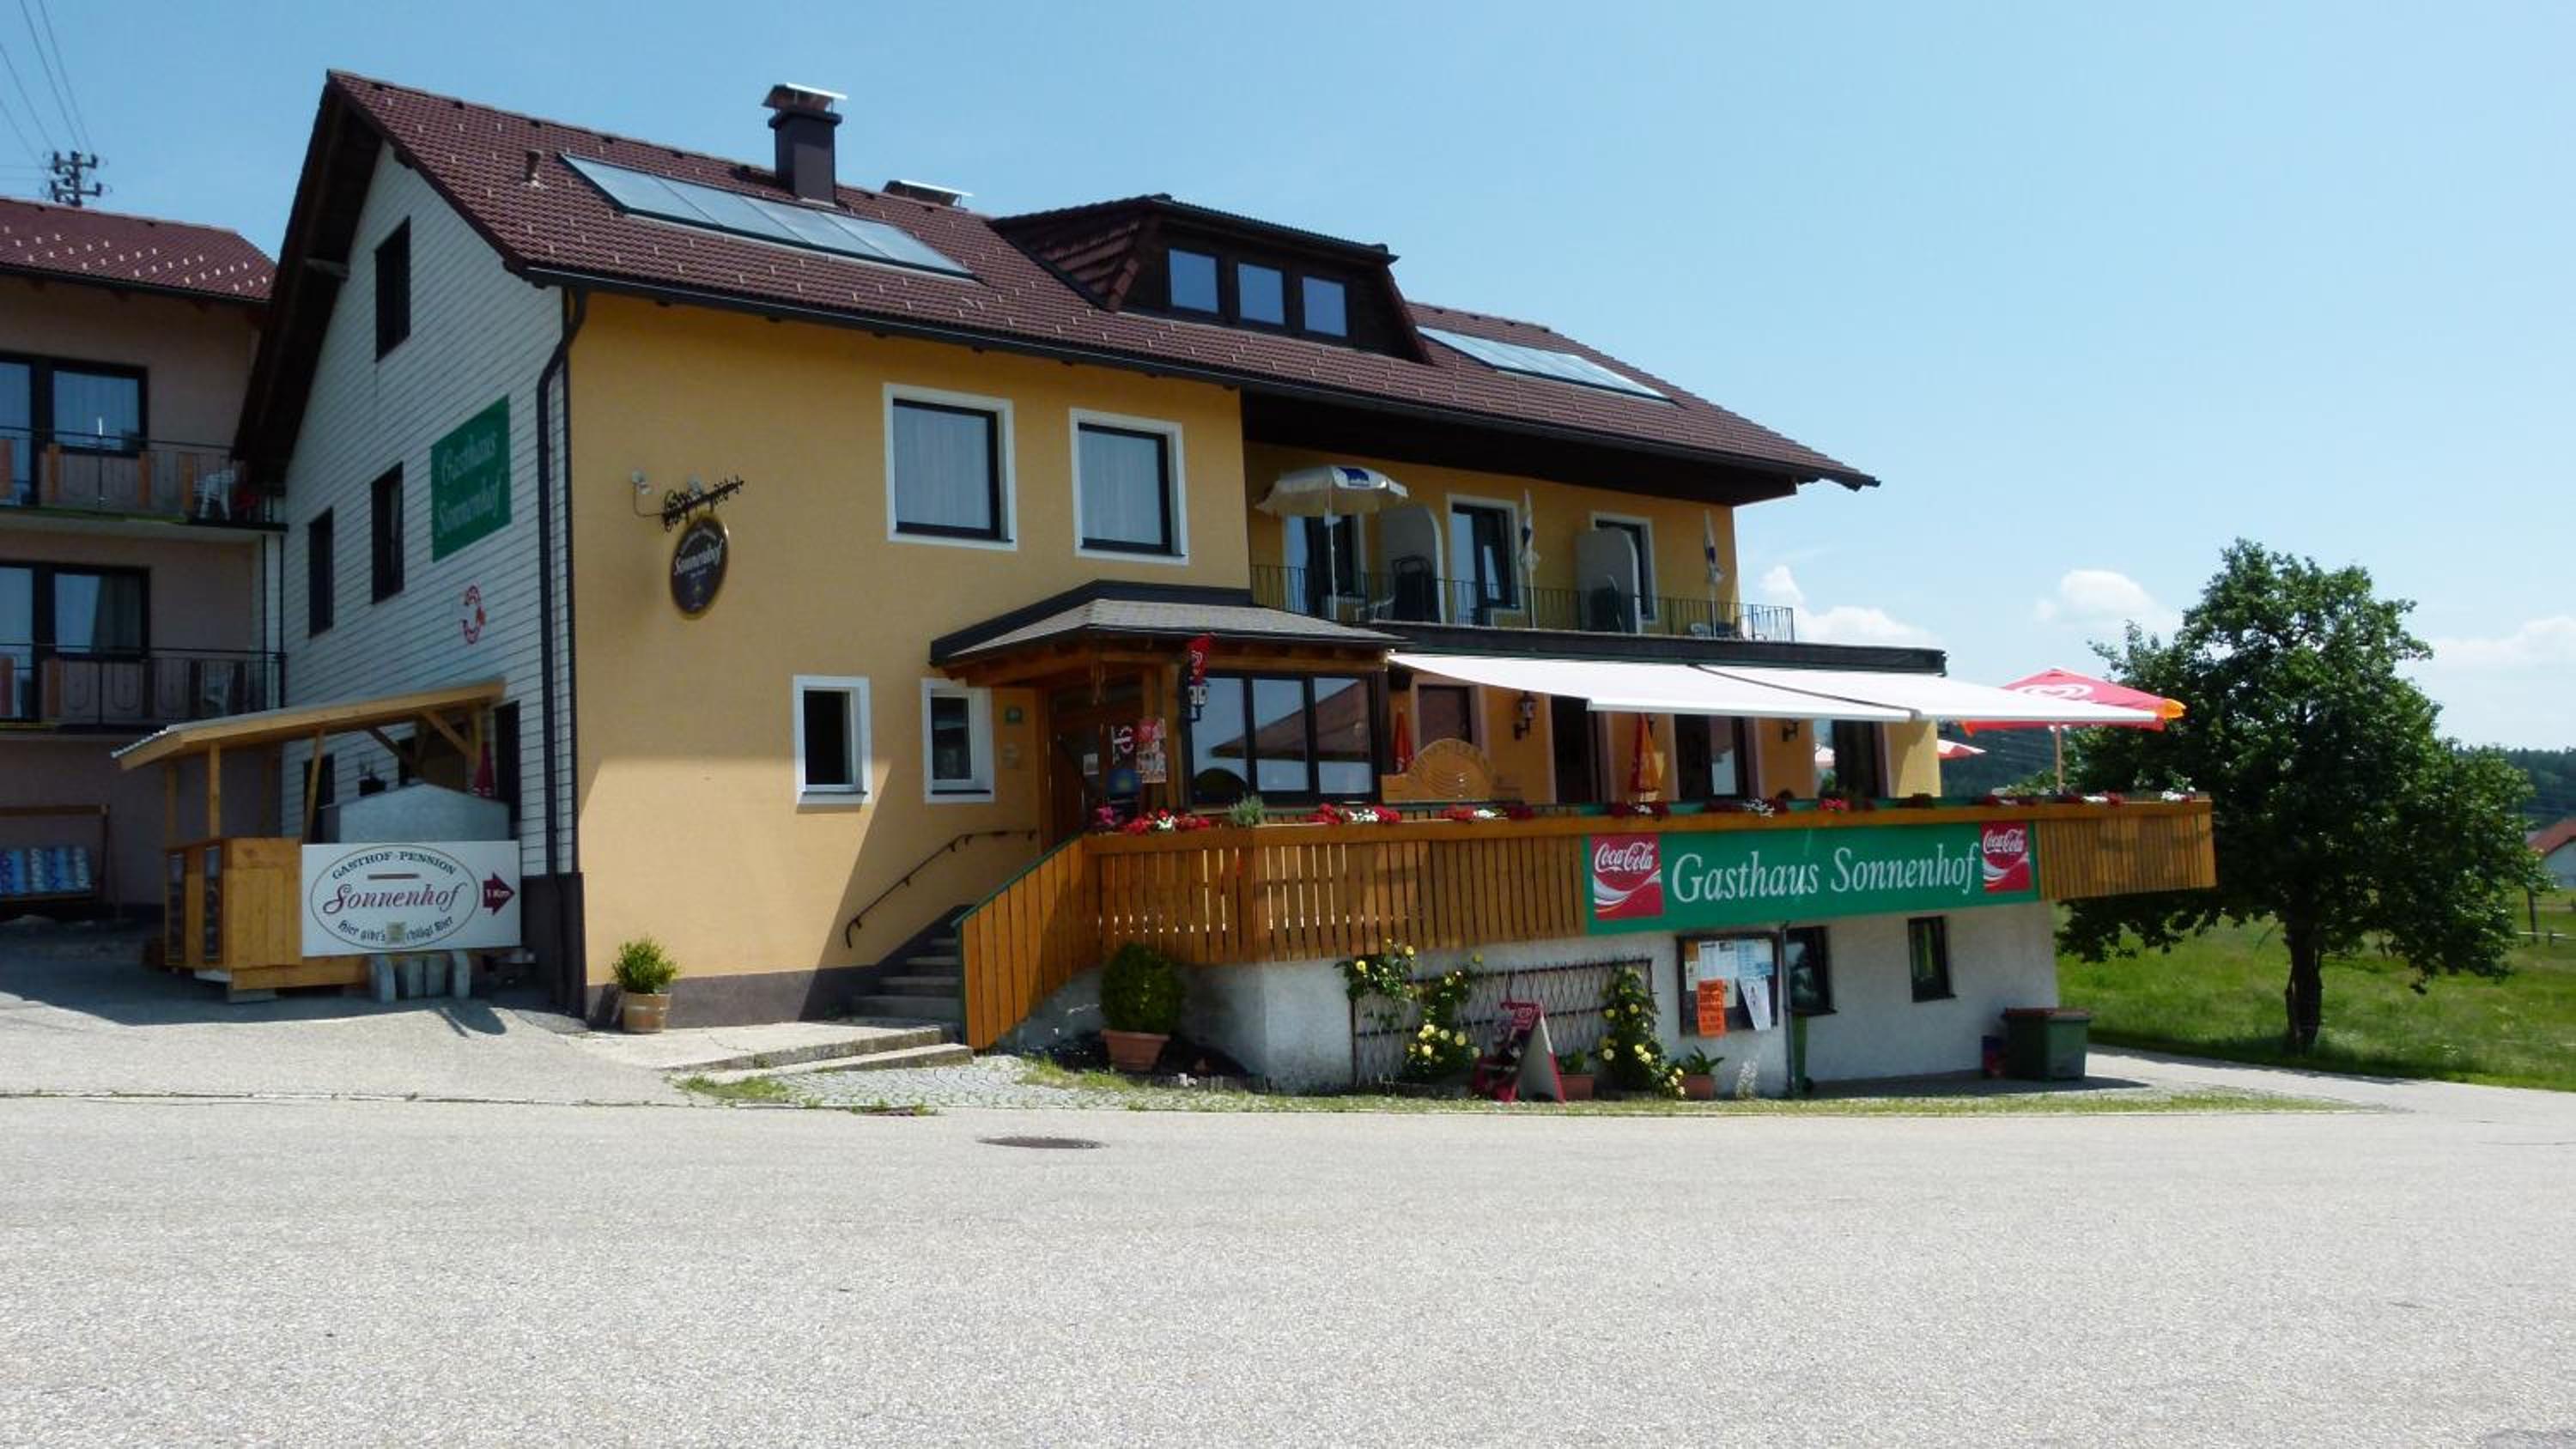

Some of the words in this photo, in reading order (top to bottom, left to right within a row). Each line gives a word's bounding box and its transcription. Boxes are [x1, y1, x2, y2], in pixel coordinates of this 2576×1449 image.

[331, 851, 394, 880] GASTHOF
[398, 851, 457, 876] PENSION
[1672, 849, 1820, 902] Gasthaus
[1830, 841, 1979, 895] Sonnenhof
[322, 881, 468, 915] Sonnenhof
